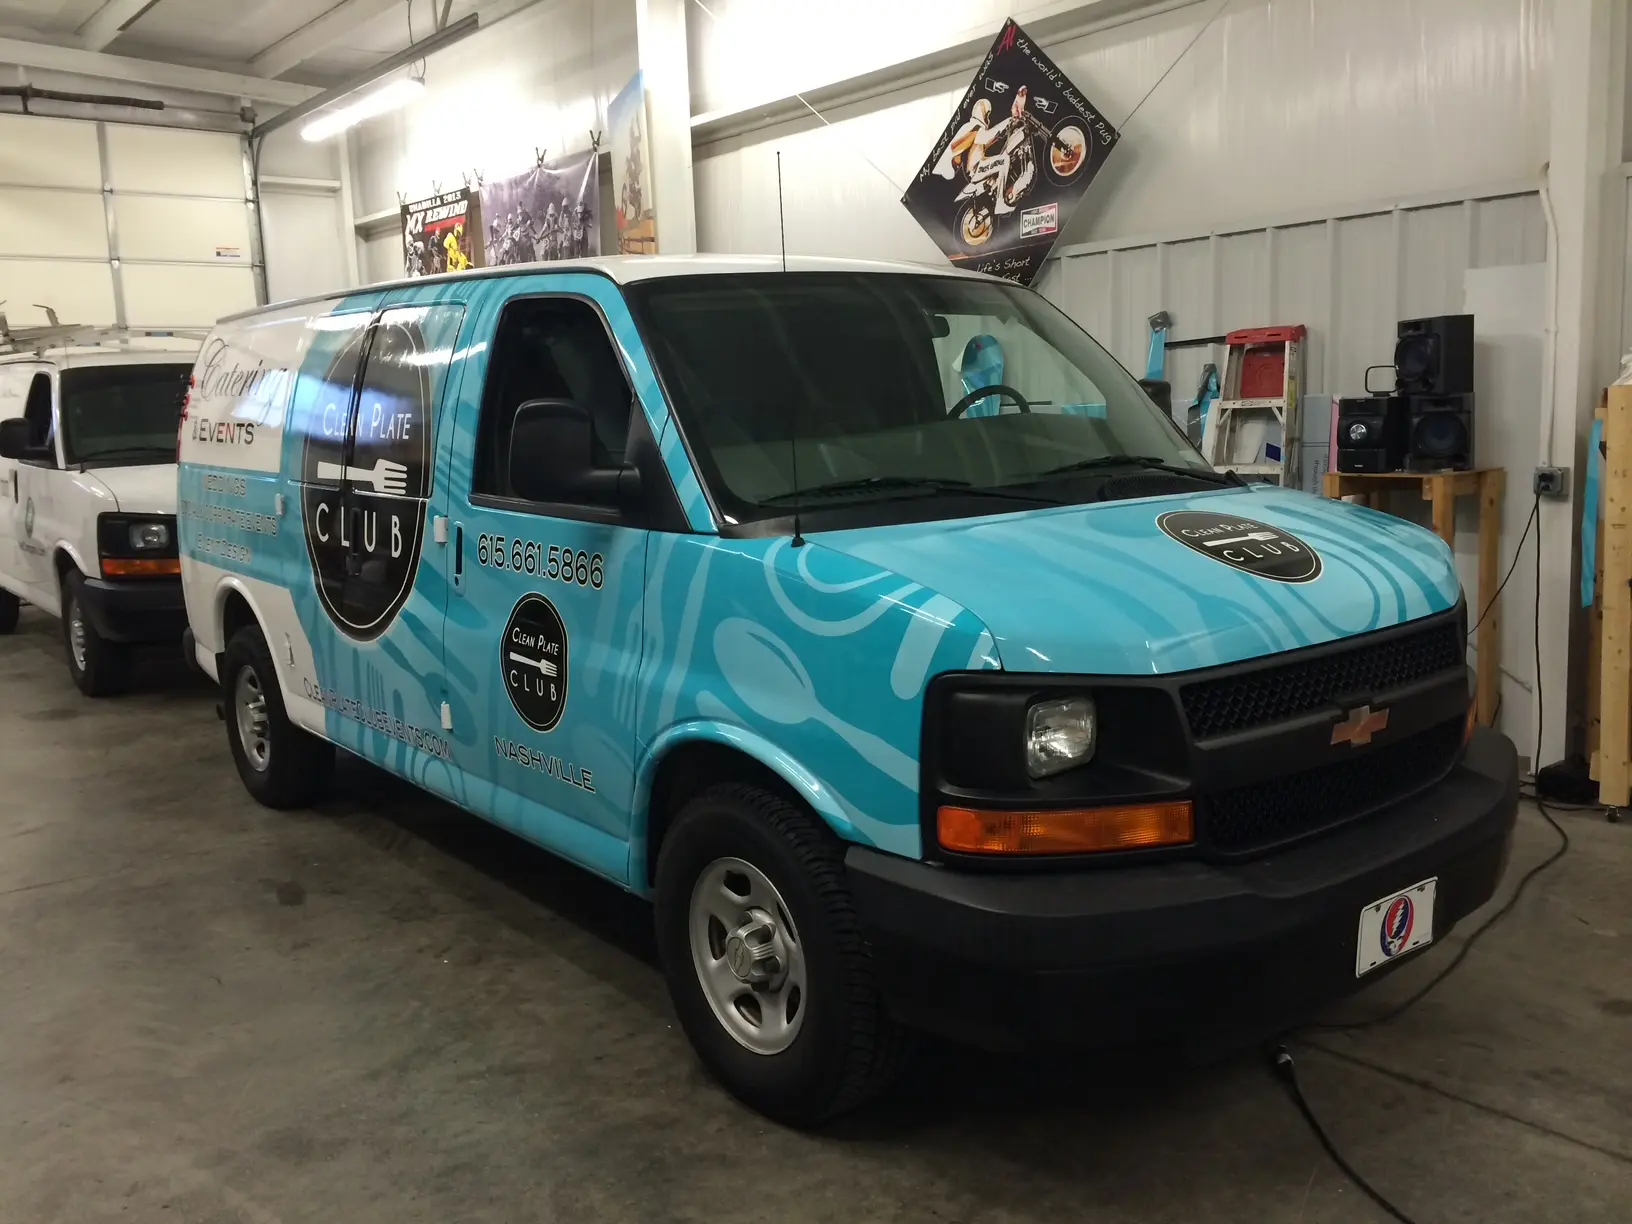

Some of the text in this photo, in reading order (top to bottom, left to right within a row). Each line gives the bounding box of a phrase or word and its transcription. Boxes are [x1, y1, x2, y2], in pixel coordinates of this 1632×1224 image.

[1016, 38, 1031, 56] the
[1032, 56, 1063, 88] world's
[1063, 87, 1095, 122] baddest
[932, 132, 949, 161] best
[963, 83, 976, 109] ever
[979, 51, 994, 80] was
[443, 191, 462, 204] 2013
[405, 200, 468, 235] MX REWIND
[1023, 213, 1055, 229] CHAMPION
[1003, 256, 1031, 270] Short
[199, 338, 288, 427] Catering
[199, 418, 254, 445] EVENTS
[370, 403, 412, 440] PLATE
[315, 502, 403, 558] CLUB
[1181, 522, 1258, 538] CLEAN PLATE
[477, 532, 605, 590] 615.661.5866
[1222, 541, 1300, 562] CLUB
[511, 627, 559, 656] CLEAN PLATE
[510, 669, 557, 702] CLUB
[493, 735, 596, 794] NASHVILLE
